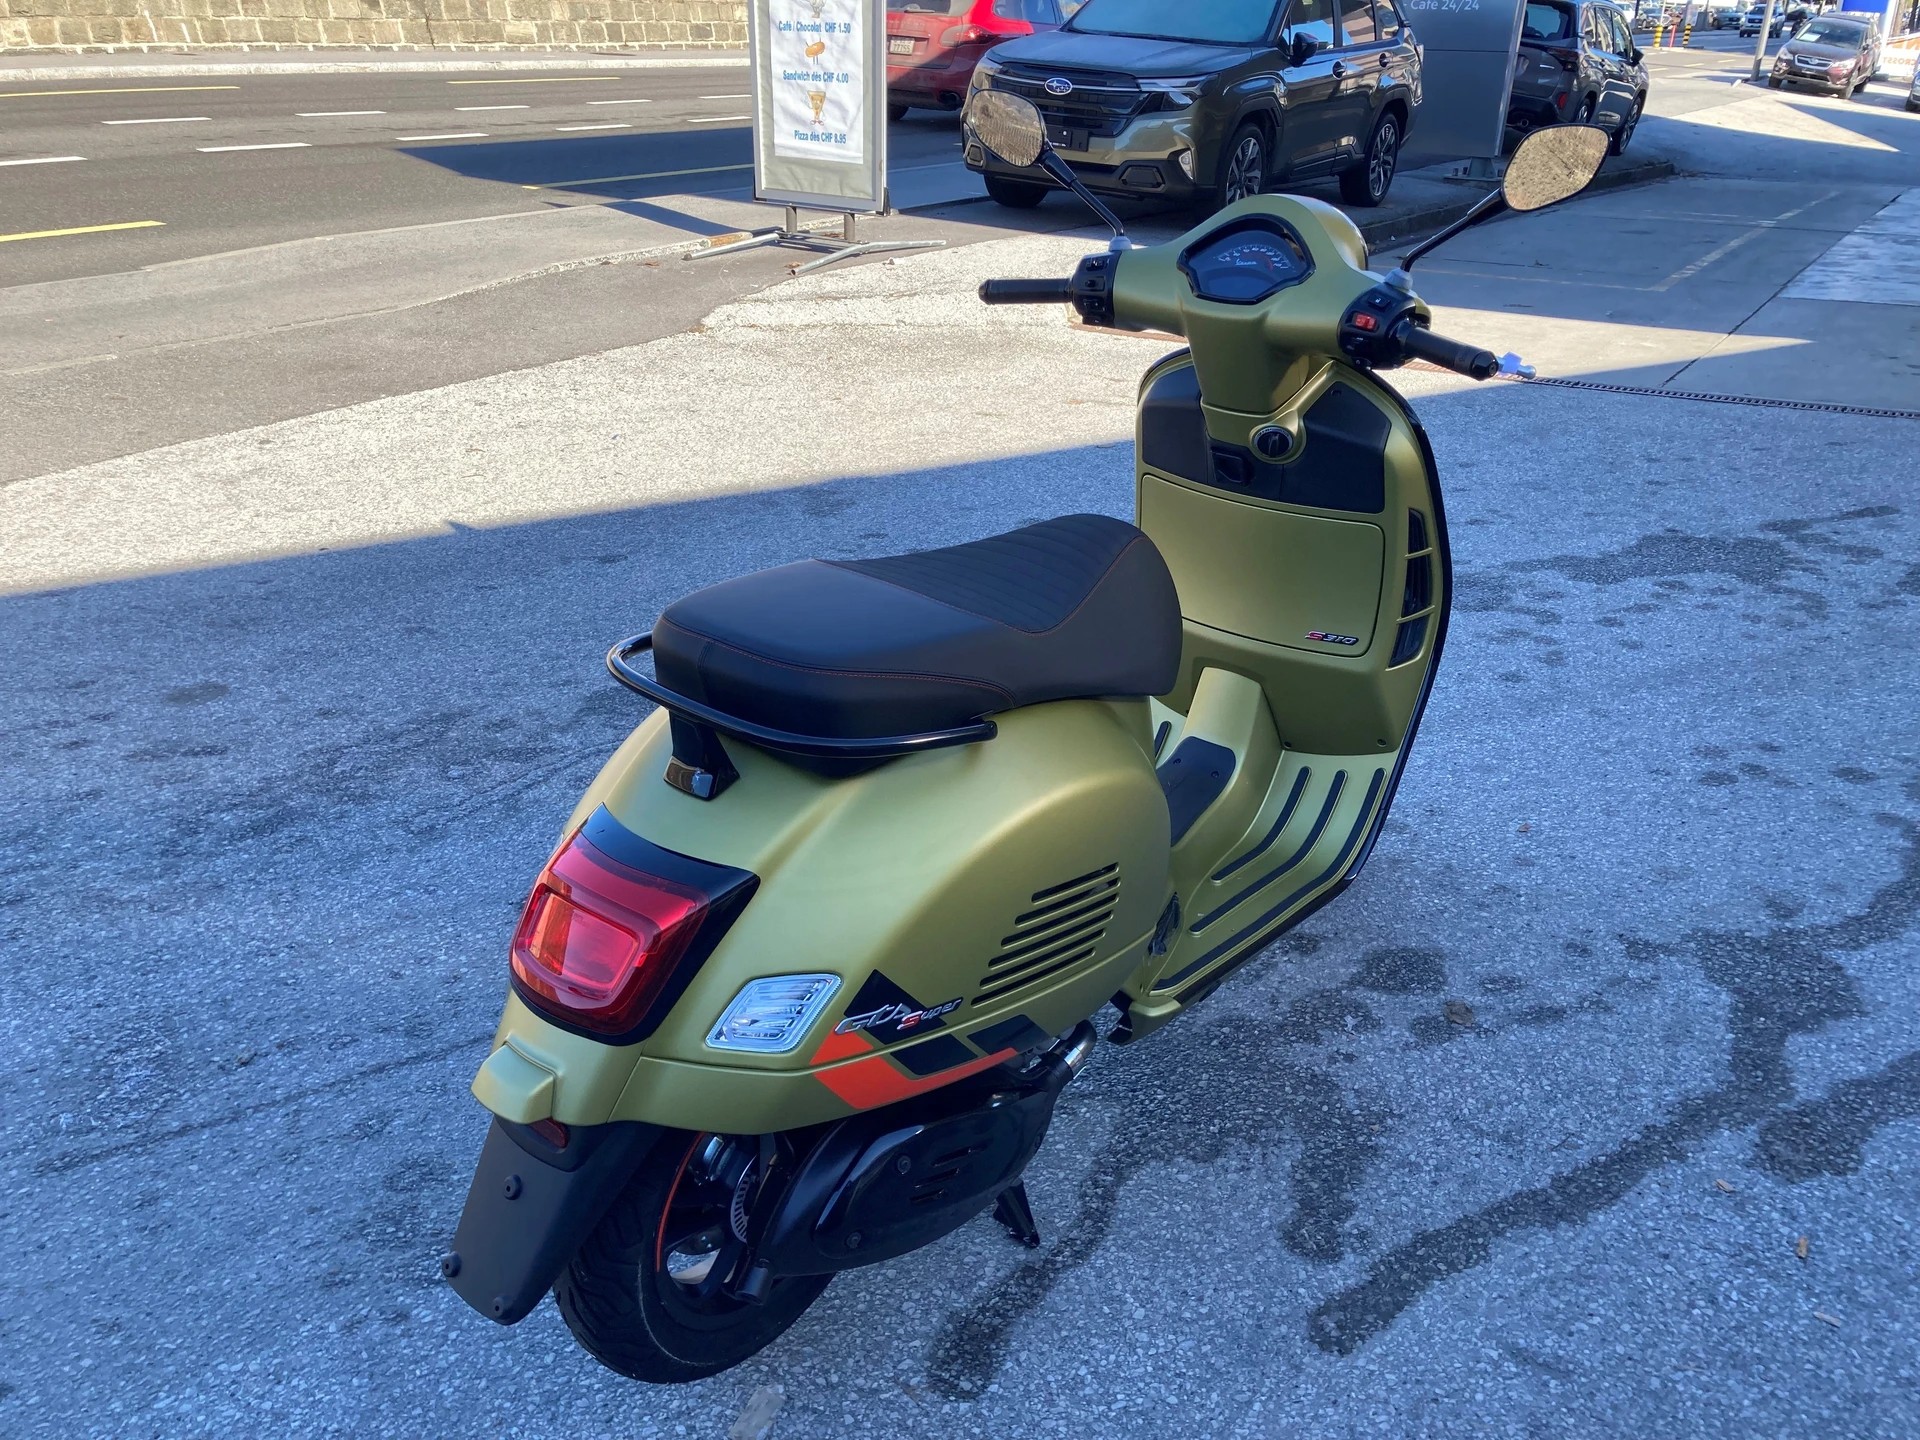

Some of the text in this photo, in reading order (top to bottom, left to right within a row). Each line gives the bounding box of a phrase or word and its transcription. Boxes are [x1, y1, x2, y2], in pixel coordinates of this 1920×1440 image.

[1441, 0, 1480, 13] 24/24
[778, 20, 792, 32] Café
[796, 20, 822, 32] Chocolat
[824, 22, 836, 33] CHF
[838, 22, 851, 34] 1.50
[783, 69, 810, 81] Sandwich
[823, 71, 834, 83] CHF
[836, 72, 849, 83] 4.00
[794, 129, 847, 144] Pizza dès CHF 8.95
